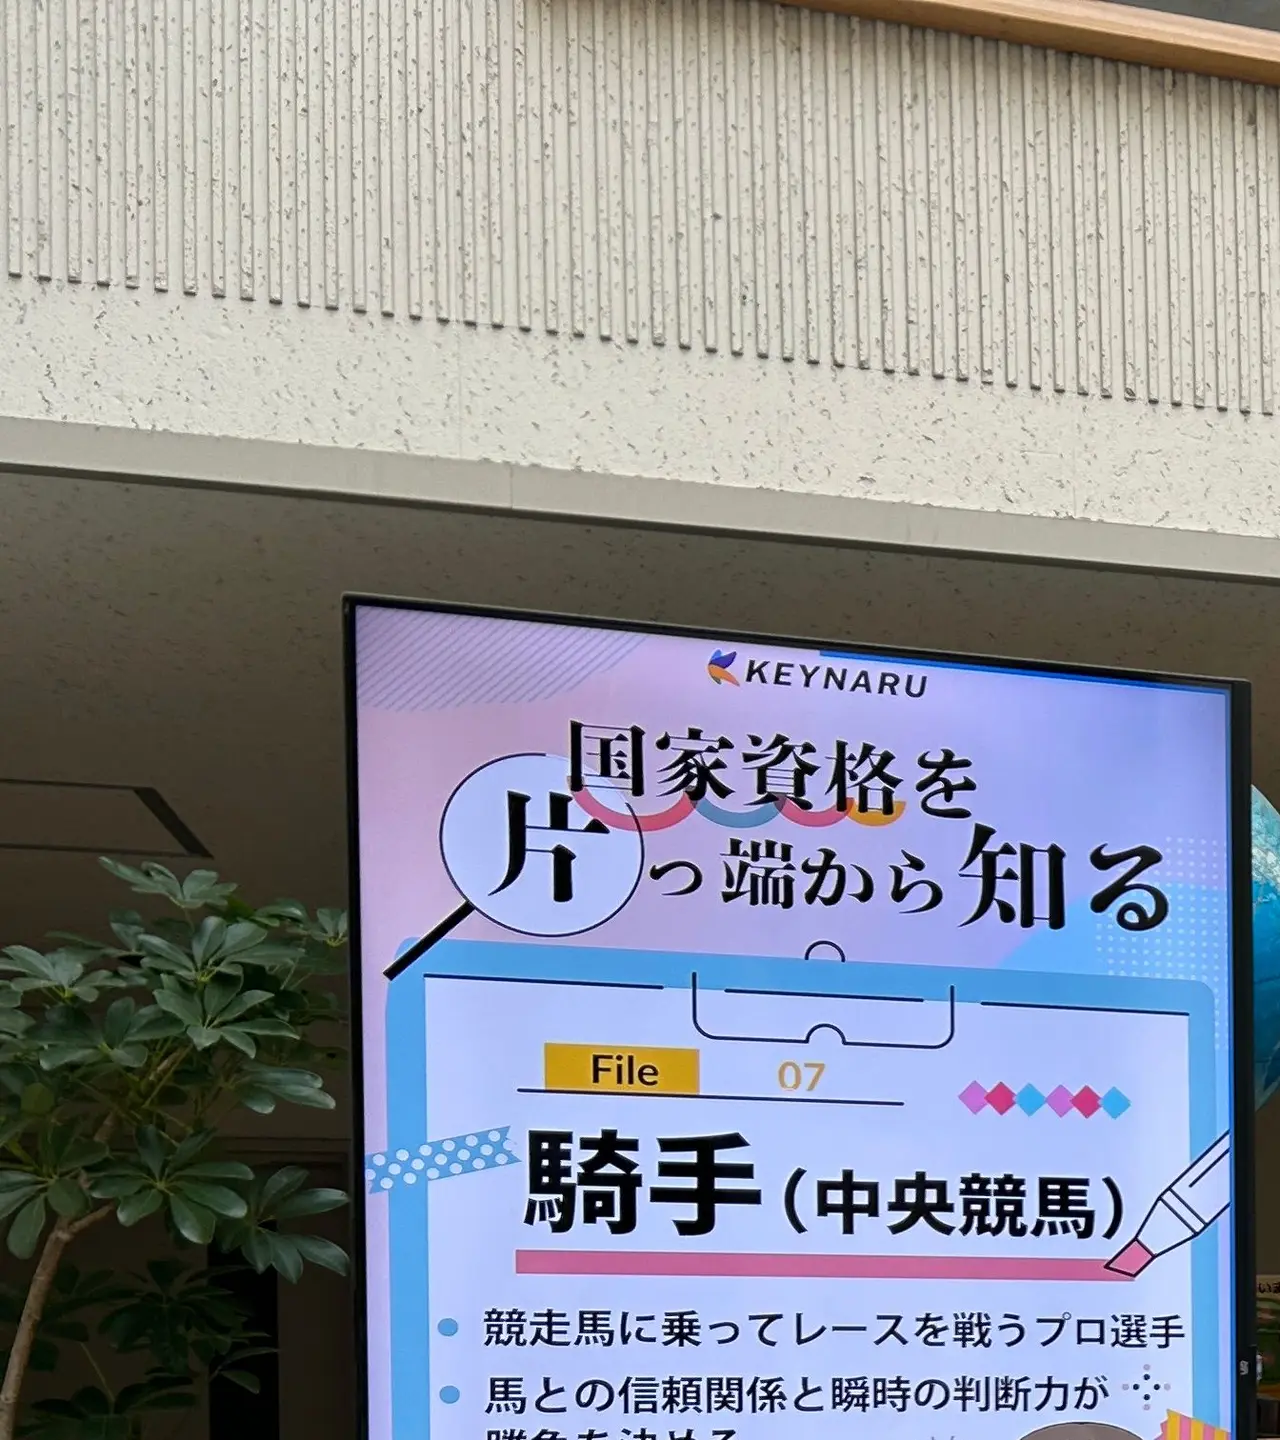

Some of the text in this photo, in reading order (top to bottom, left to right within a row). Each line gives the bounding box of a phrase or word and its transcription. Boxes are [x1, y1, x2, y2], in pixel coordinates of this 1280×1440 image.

[746, 657, 928, 699] KEYNARU
[569, 719, 977, 819] 国家資格を
[487, 790, 1170, 932] 片っ端から知る
[590, 1054, 826, 1093] File 07
[483, 1309, 1185, 1351] 競走馬に乗ってレースを戦うプロ選手
[485, 1375, 1110, 1417] 馬との信頼関係と瞬時の判断力が
